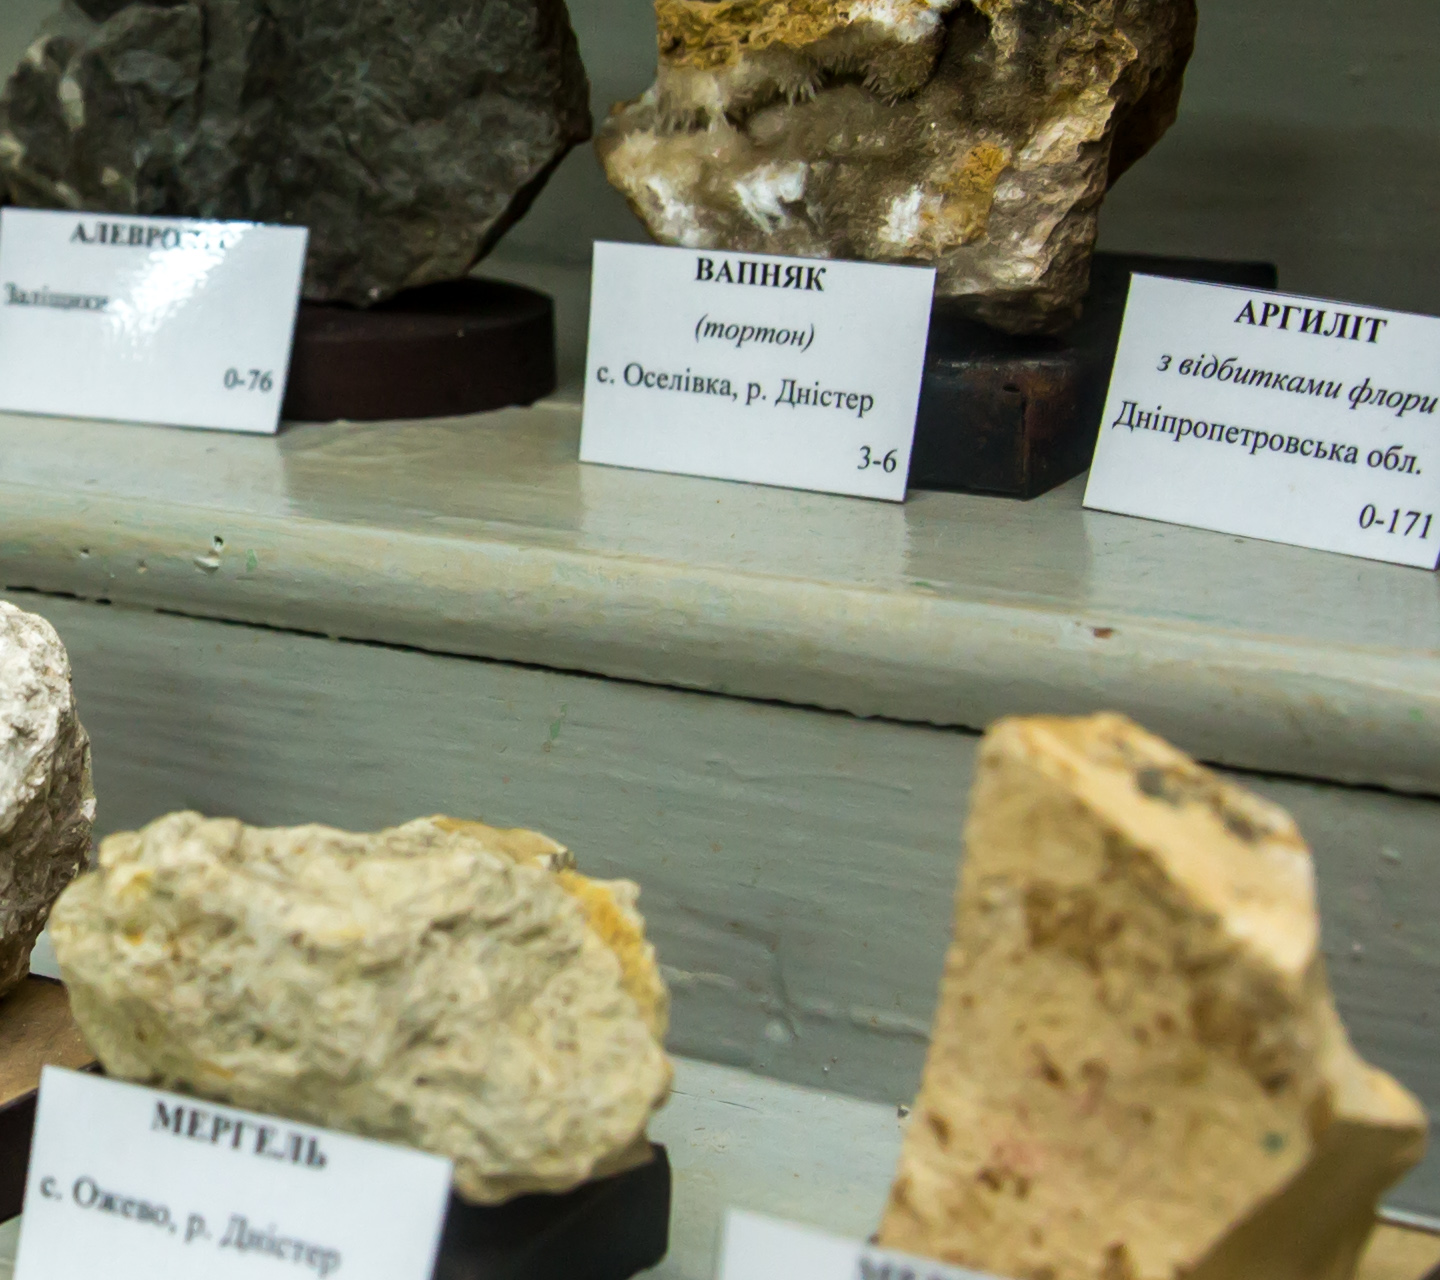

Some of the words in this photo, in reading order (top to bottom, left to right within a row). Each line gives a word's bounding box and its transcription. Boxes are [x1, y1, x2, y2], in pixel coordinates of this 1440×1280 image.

[70, 221, 230, 251] АЛЕВРО
[695, 257, 827, 292] ВАПНЯК
[694, 314, 815, 353] (тортон)
[1233, 299, 1388, 344] АРГИЛІТ
[224, 367, 273, 392] 0-76
[596, 365, 615, 385] с.
[622, 362, 739, 402] Оселівка,
[745, 381, 767, 405] р.
[775, 378, 875, 418] Дністер
[1156, 354, 1172, 373] з
[1178, 353, 1344, 400] відбитками
[1348, 378, 1440, 419] флори
[857, 445, 898, 474] 3-6
[1112, 400, 1358, 466] Дніпропетровська
[1366, 444, 1422, 477] обл.
[1358, 504, 1434, 540] 0-171
[151, 1100, 328, 1169] МЕРГЕЛЬ
[39, 1173, 63, 1200] с.
[184, 1214, 213, 1245] р.
[219, 1214, 343, 1279] Дністер
